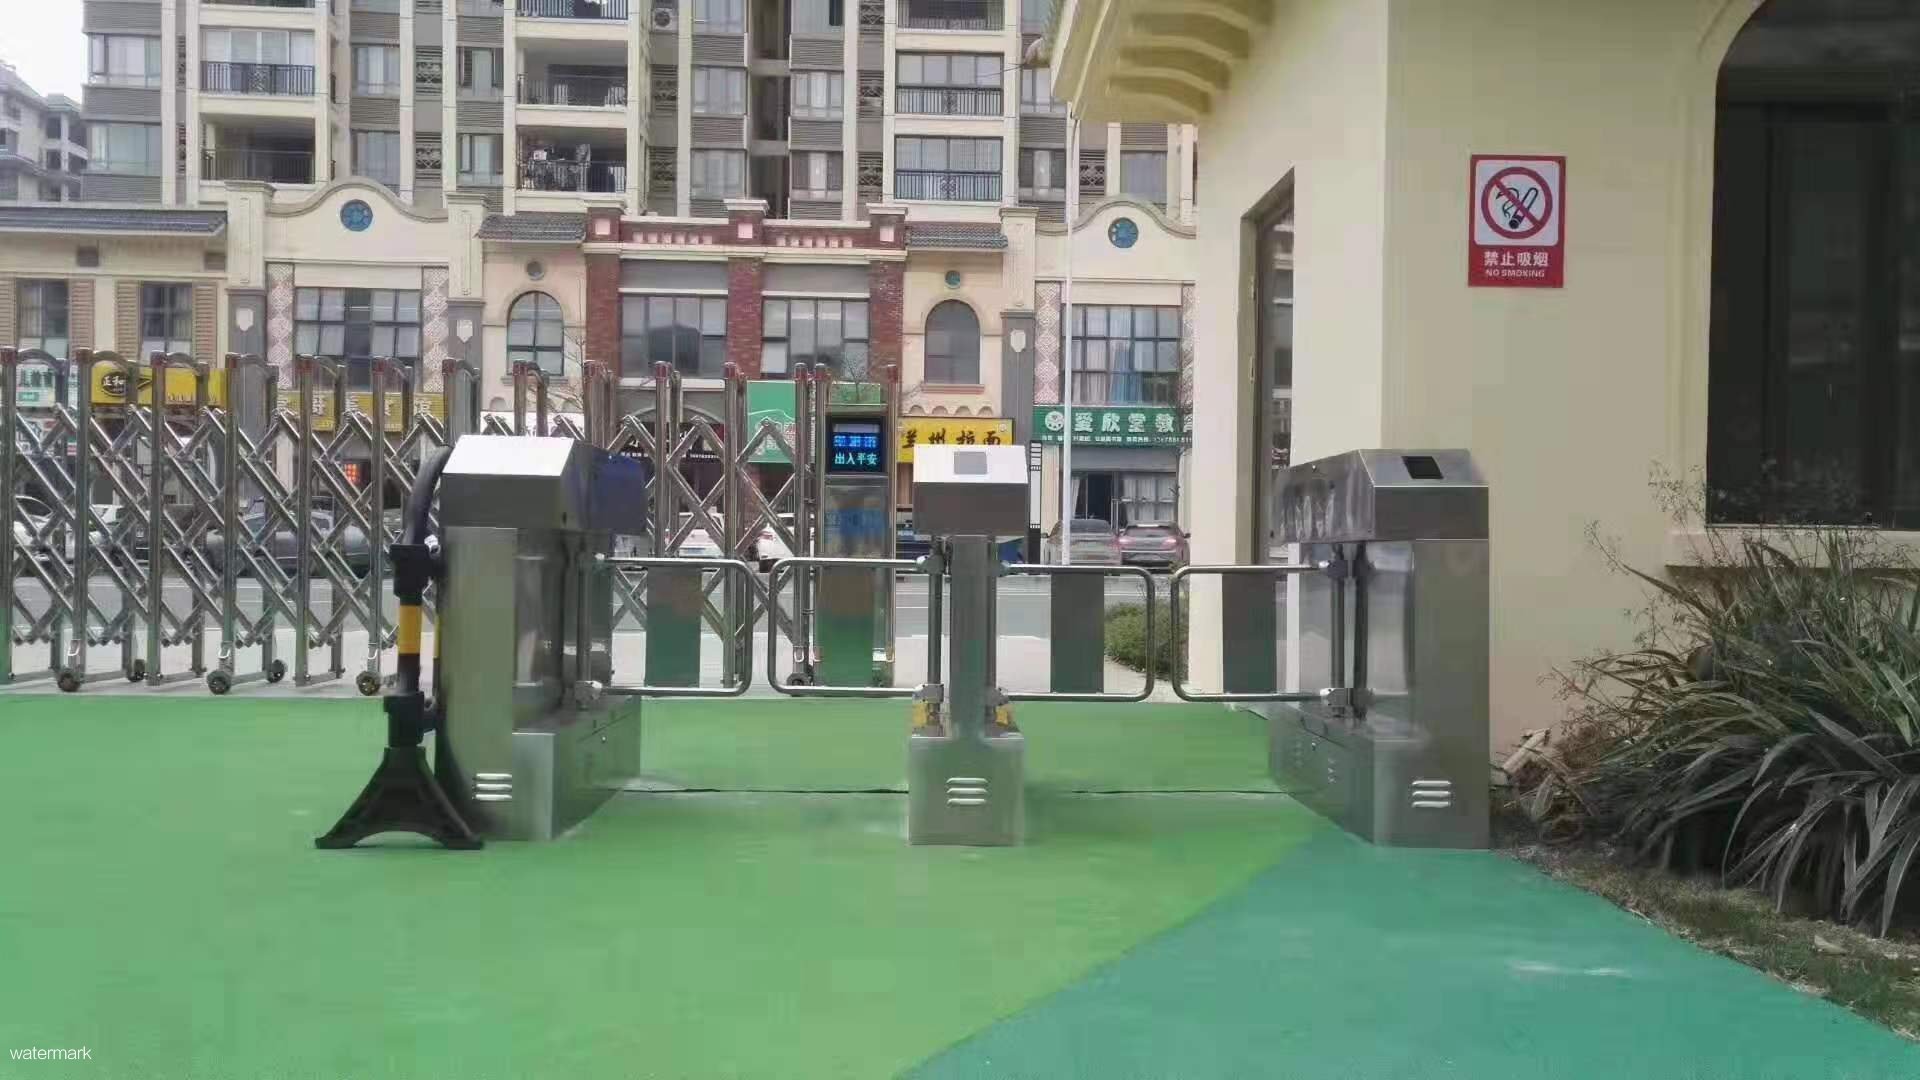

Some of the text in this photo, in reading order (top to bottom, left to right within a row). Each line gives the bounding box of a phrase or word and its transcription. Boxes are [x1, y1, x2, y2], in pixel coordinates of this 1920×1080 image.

[1484, 251, 1548, 267] 禁止吸烟
[1486, 269, 1545, 278] NO SMOKING
[834, 451, 878, 465] 出入平安
